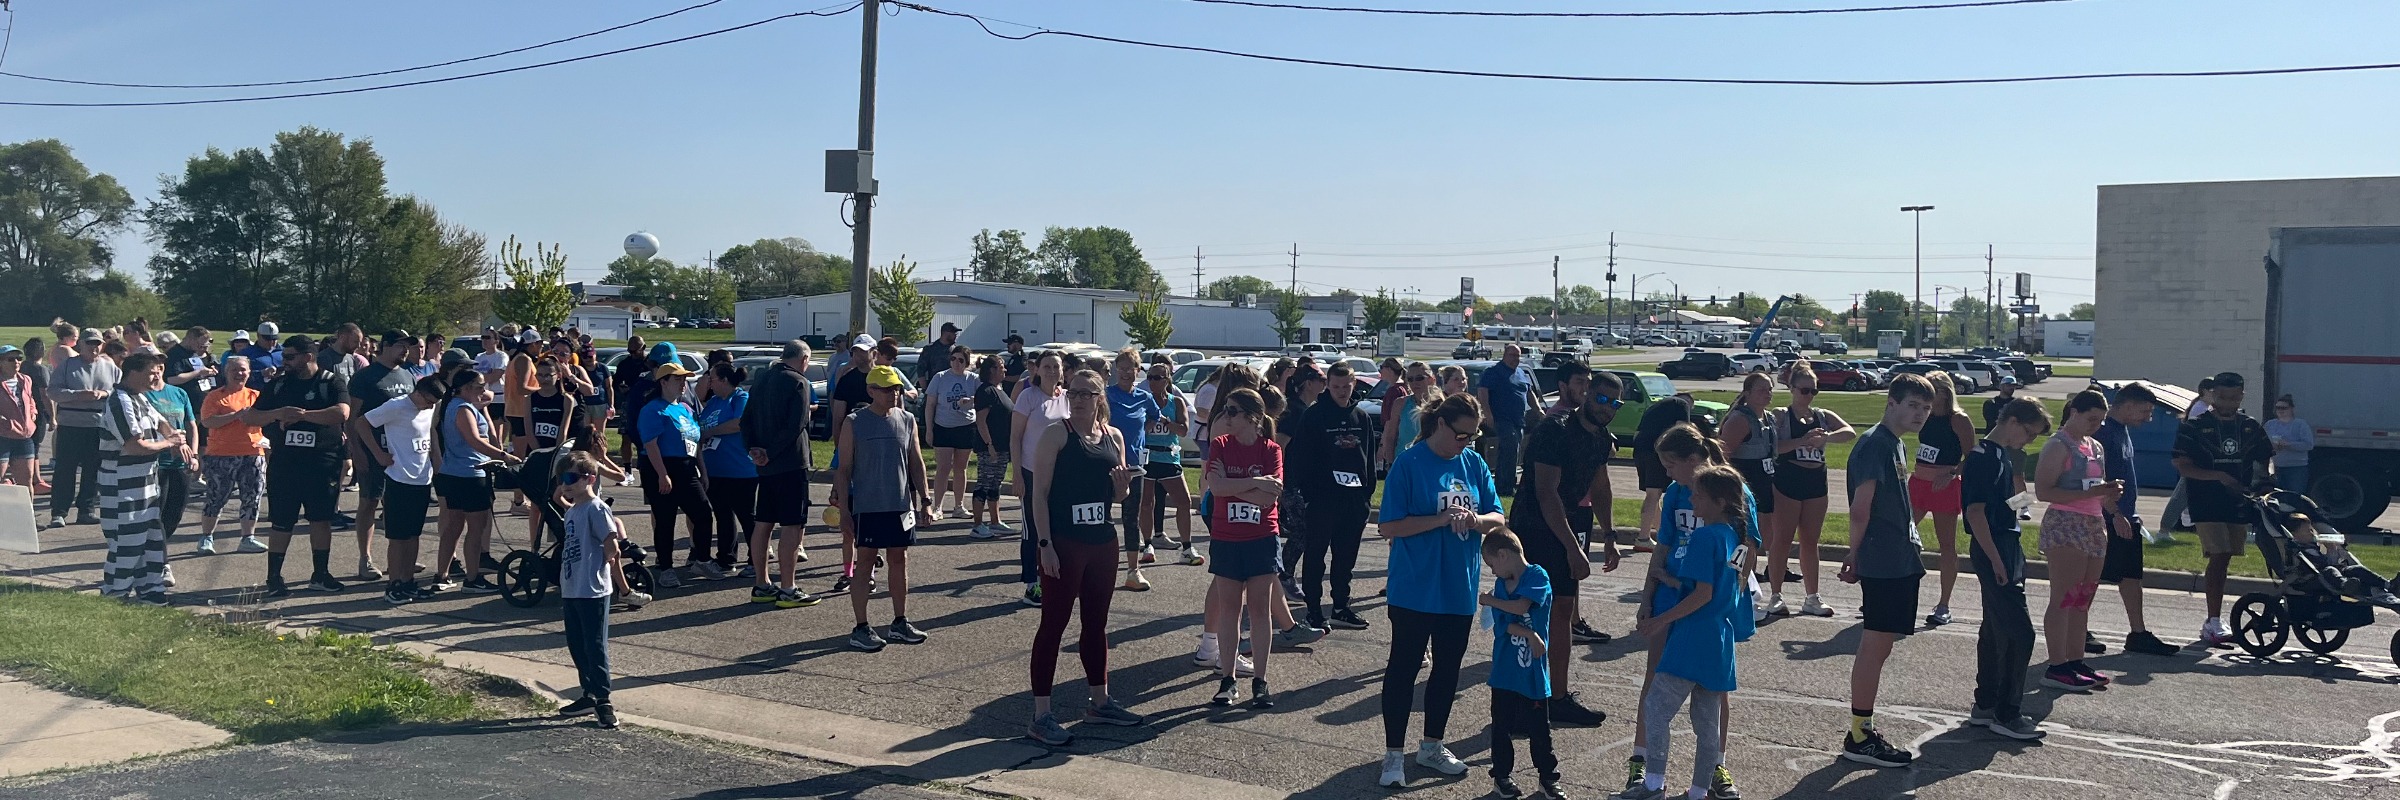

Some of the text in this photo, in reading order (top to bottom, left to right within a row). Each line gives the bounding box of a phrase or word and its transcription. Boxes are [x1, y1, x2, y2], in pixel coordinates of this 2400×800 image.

[766, 321, 778, 329] 35
[535, 424, 558, 437] 198
[1150, 422, 1169, 434] 190
[288, 432, 315, 446] 199
[1917, 444, 1937, 461] 168
[1336, 472, 1358, 485] 124
[1440, 495, 1471, 513] 108
[1075, 505, 1103, 523] 118
